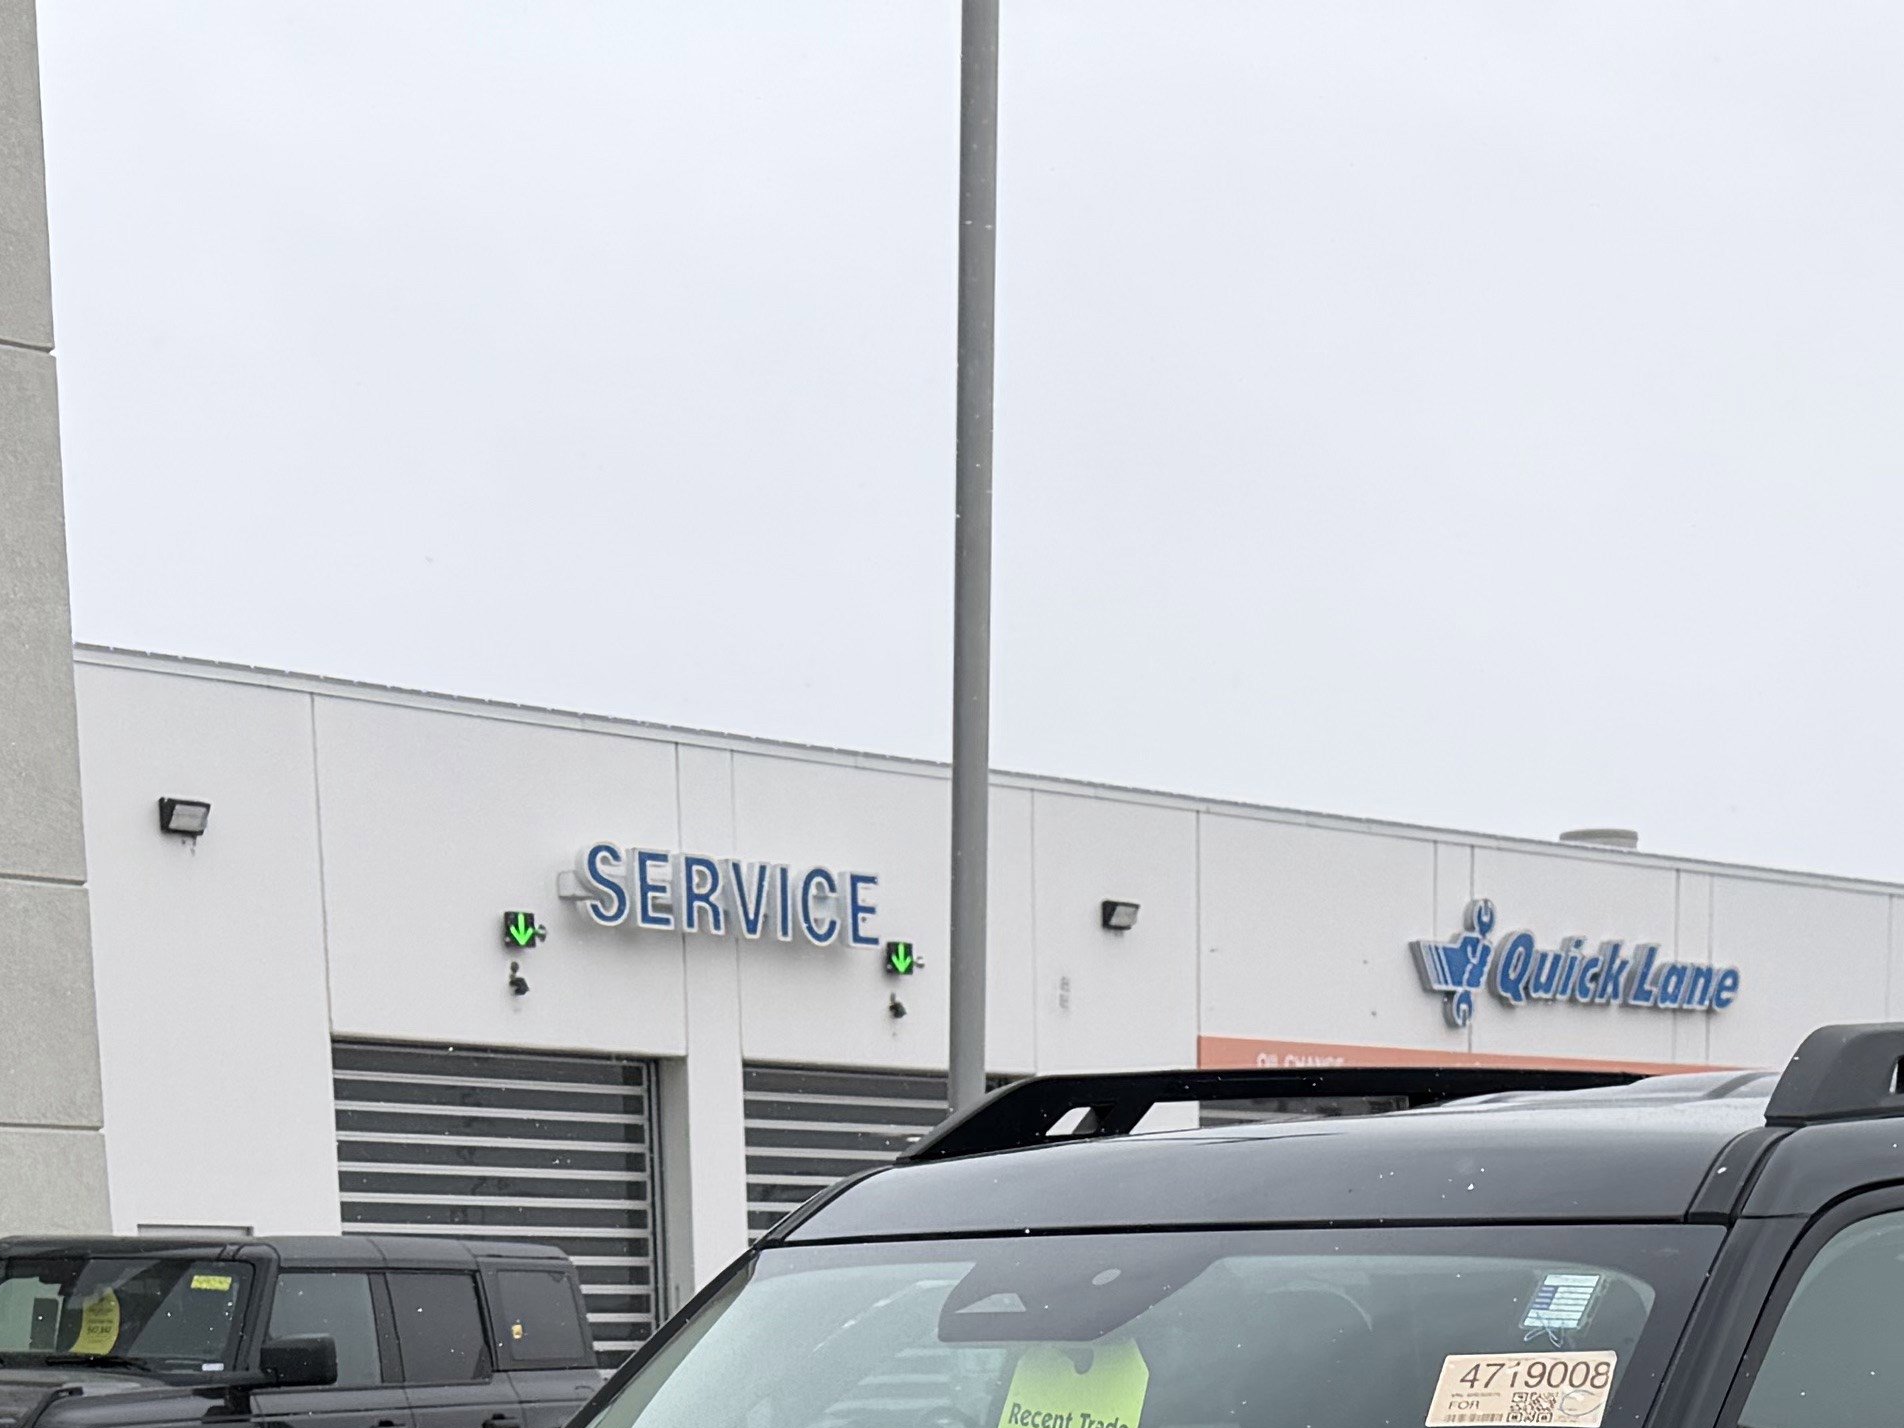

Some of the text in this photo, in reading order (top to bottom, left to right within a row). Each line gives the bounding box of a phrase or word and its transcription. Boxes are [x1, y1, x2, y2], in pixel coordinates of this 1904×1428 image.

[585, 843, 881, 947] SERVICE
[1498, 931, 1741, 1010] Quick Lane
[1459, 1361, 1611, 1390] 4719008
